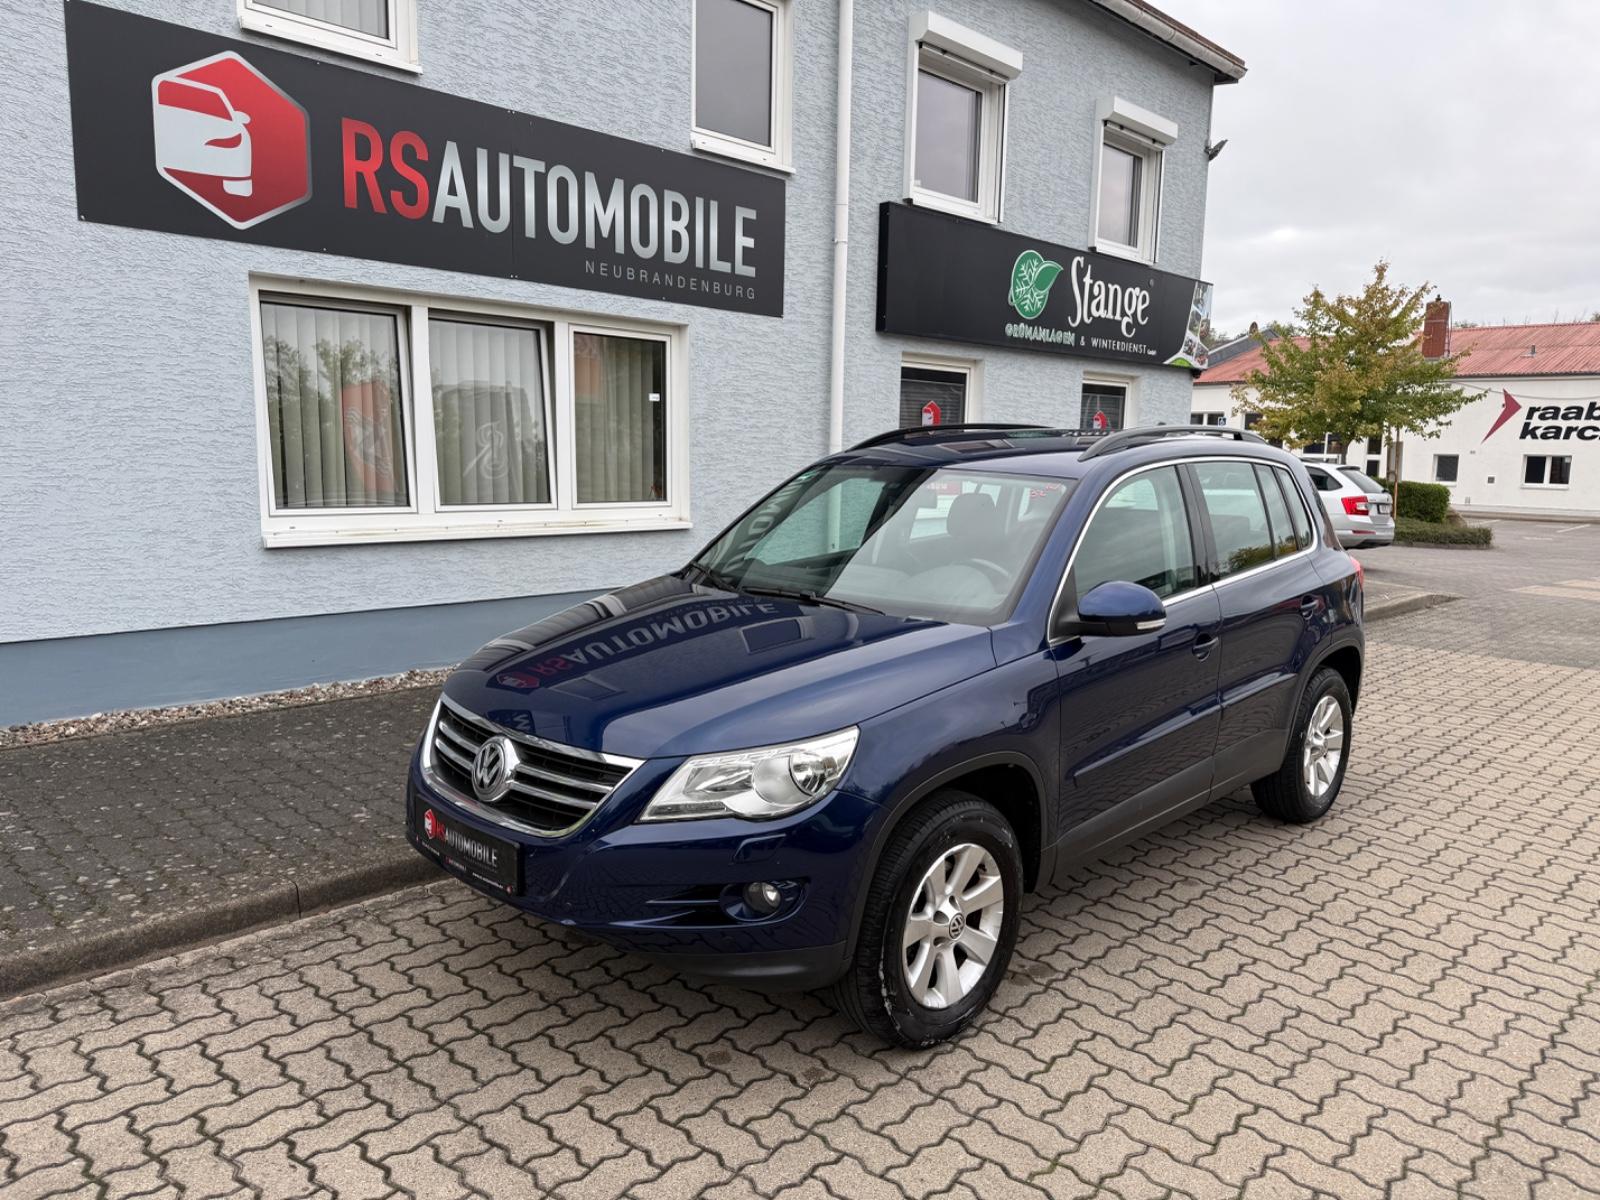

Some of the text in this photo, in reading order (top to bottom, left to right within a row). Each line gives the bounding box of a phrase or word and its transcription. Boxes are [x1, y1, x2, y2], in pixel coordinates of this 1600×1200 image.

[585, 260, 756, 300] NEUBRANDENBURG
[1068, 256, 1150, 338] Stange
[1080, 336, 1086, 346] &
[1091, 337, 1147, 355] WINTERDIENST
[1525, 402, 1600, 420] raab
[1519, 422, 1600, 441] karc
[477, 743, 503, 791] VW
